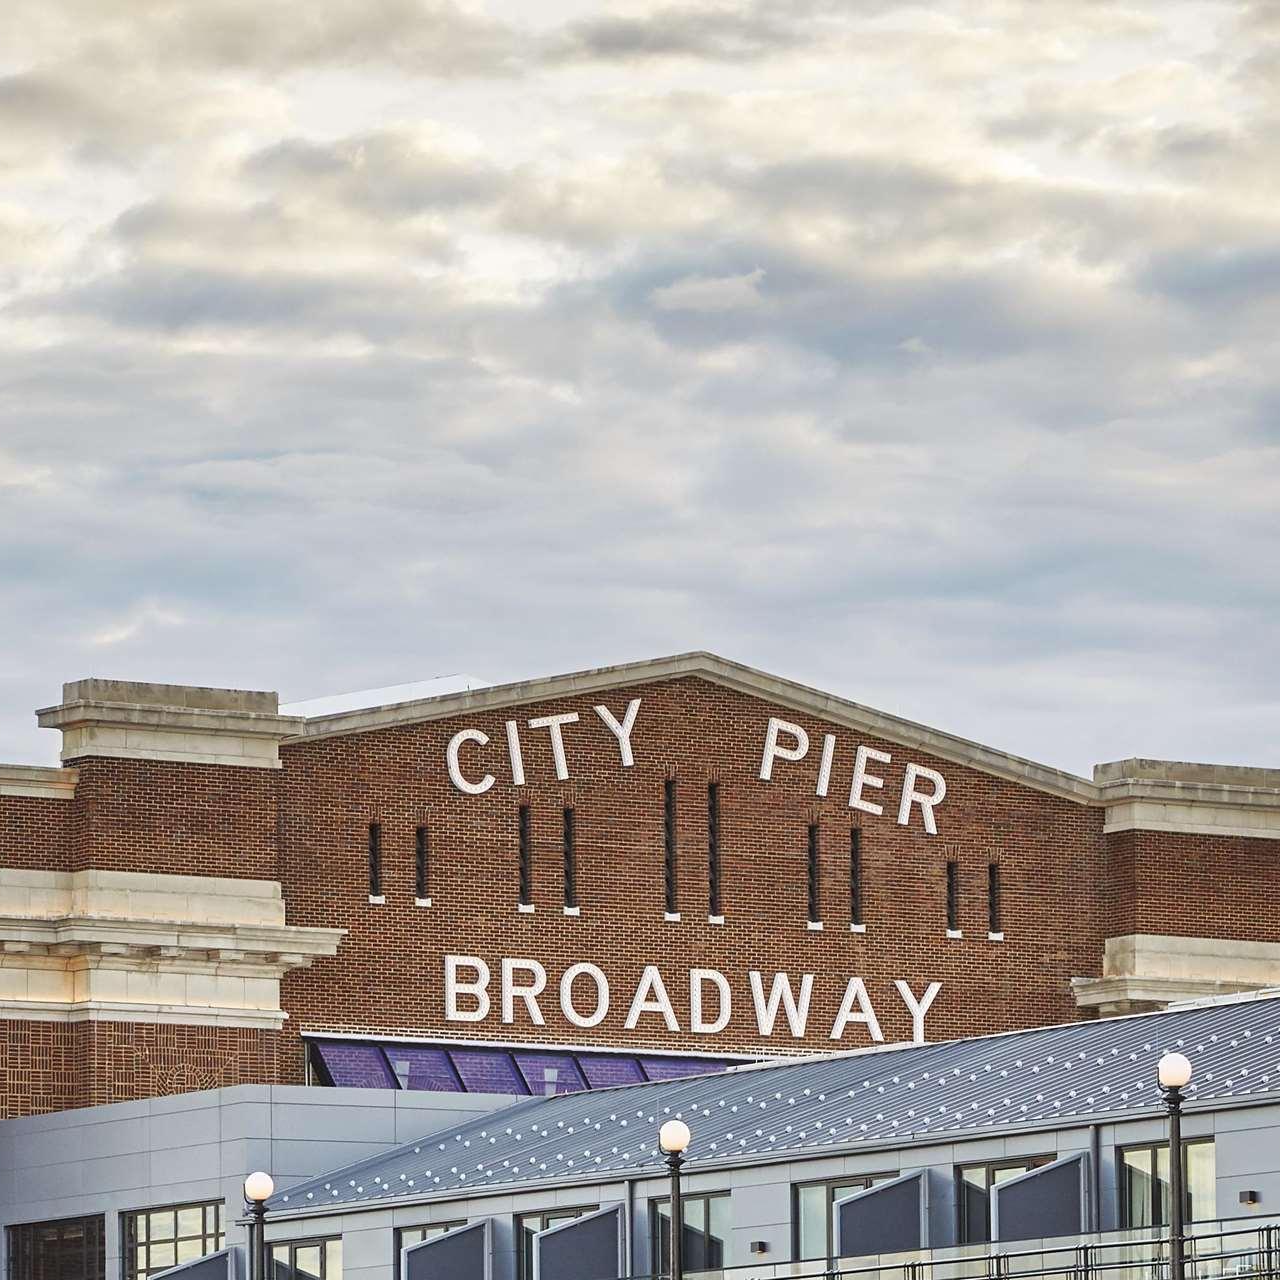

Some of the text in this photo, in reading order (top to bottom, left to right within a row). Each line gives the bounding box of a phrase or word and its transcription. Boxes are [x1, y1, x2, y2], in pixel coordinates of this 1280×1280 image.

[446, 697, 947, 835] CITY PIER
[444, 954, 944, 1043] BROADWAY
